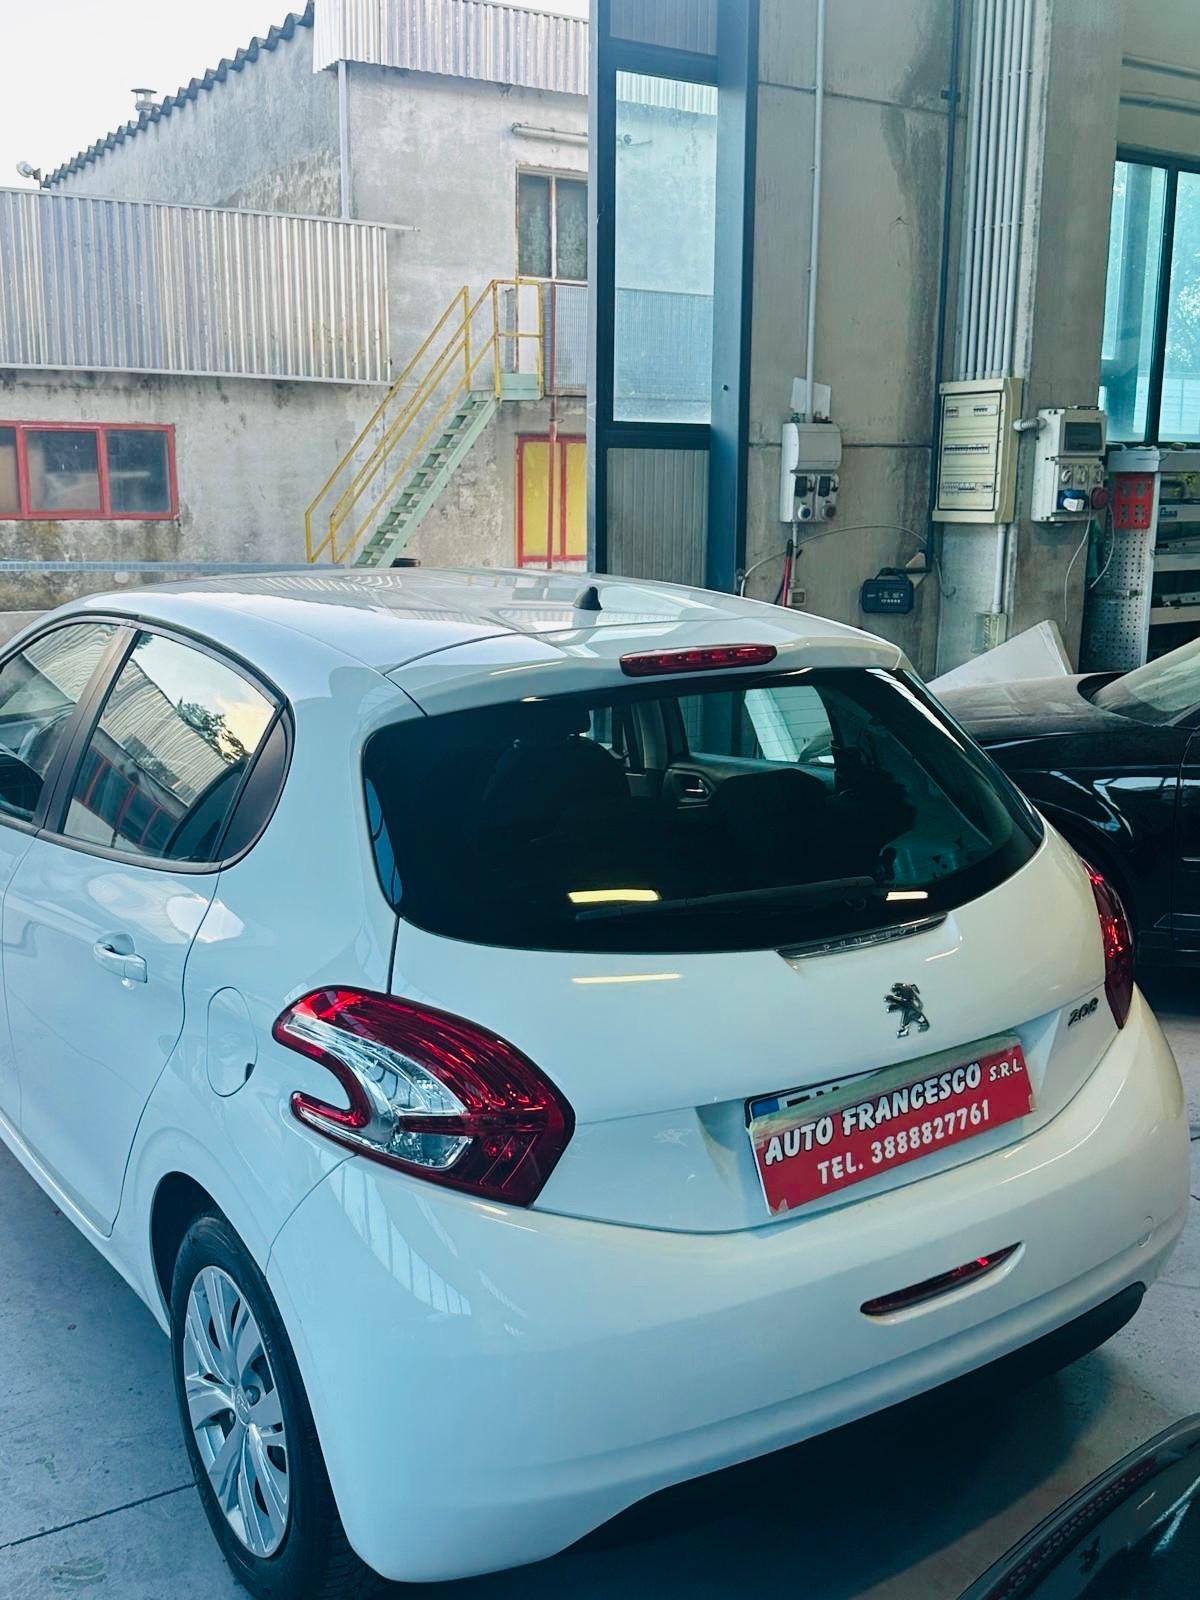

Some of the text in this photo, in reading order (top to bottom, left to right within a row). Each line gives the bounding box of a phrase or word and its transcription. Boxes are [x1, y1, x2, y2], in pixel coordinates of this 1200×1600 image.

[1068, 997, 1099, 1026] 208
[764, 1116, 834, 1166] AUTO
[841, 1062, 982, 1136] FRANCESCO
[988, 1057, 1023, 1082] S.R.L.
[817, 1099, 990, 1185] TEL. 3888827761
